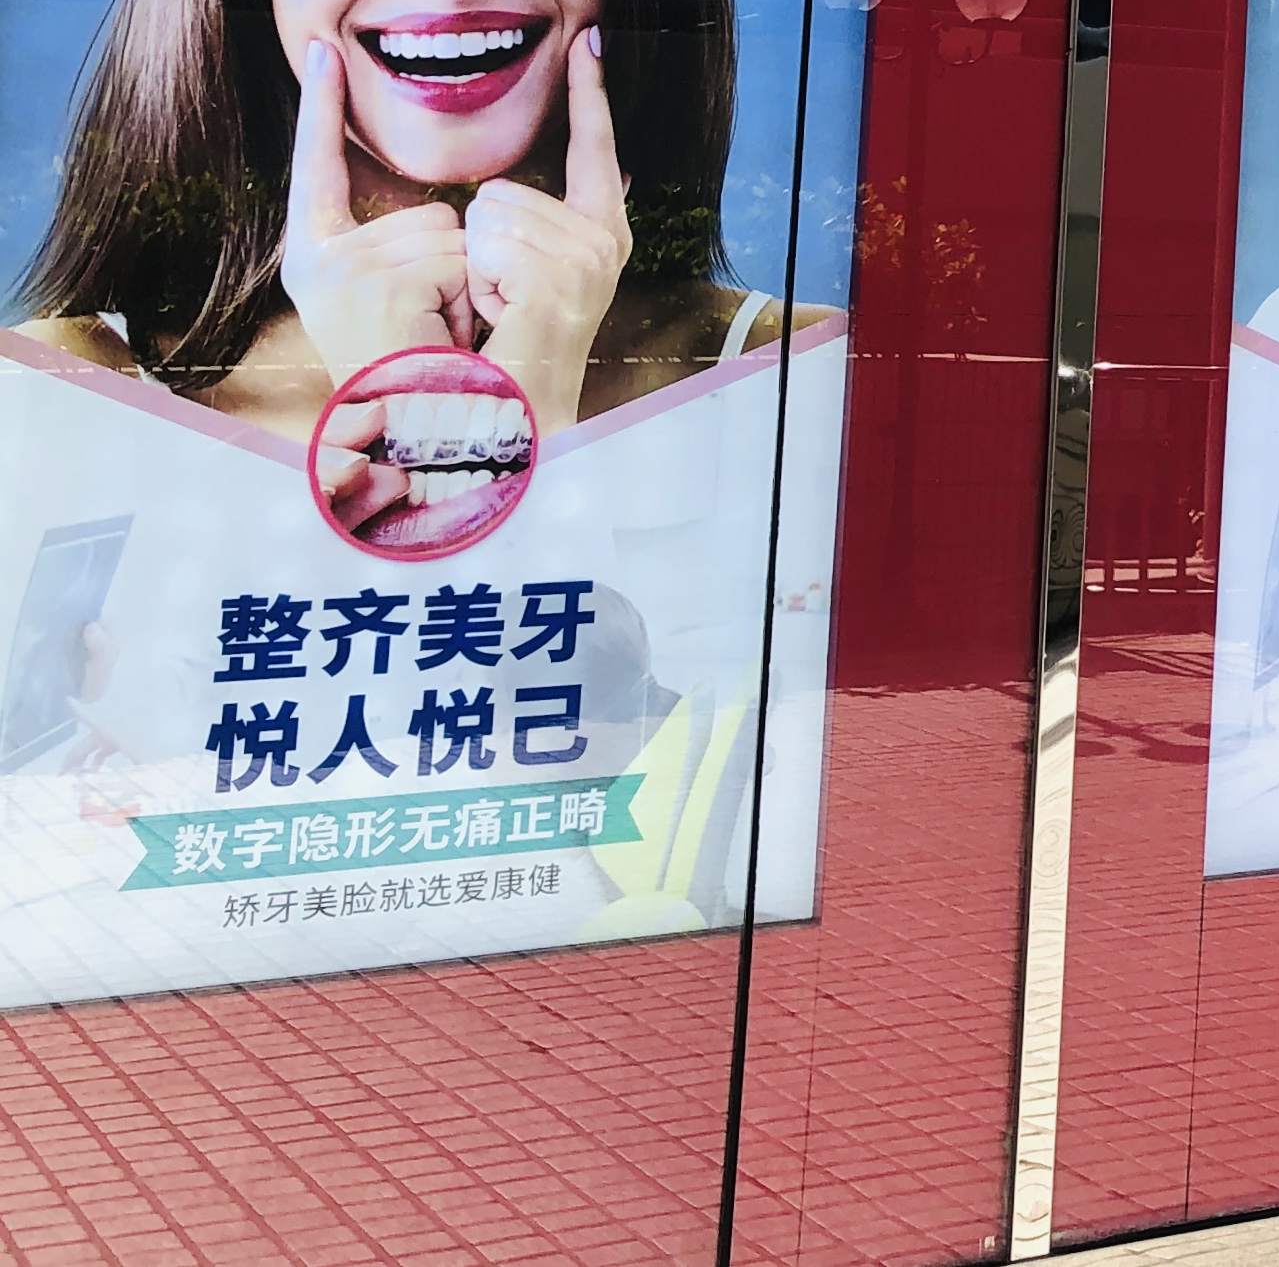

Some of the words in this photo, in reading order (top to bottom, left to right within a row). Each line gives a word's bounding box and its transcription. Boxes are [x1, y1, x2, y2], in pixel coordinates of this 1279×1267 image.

[213, 579, 597, 684] 整齐美牙
[205, 684, 590, 794] 悦人悦己
[172, 788, 607, 876] 数字隐形无痛正畸
[222, 862, 562, 930] 矫牙美脸就选爱康健
